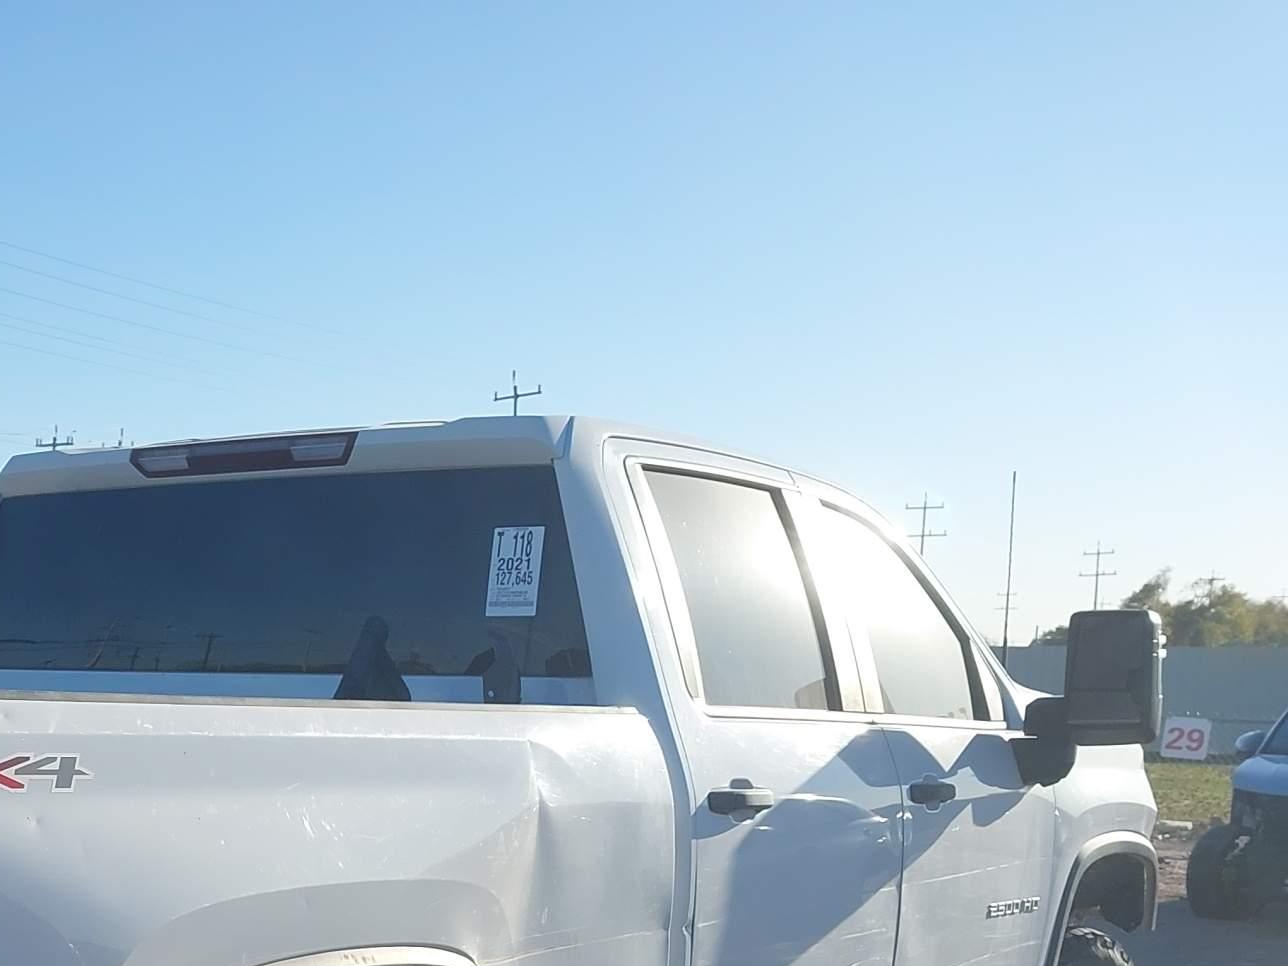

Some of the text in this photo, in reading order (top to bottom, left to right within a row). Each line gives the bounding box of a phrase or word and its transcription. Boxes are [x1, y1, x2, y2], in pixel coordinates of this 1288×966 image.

[496, 530, 533, 557] T 118
[496, 557, 531, 571] 2021
[495, 571, 533, 587] 127,645
[1164, 727, 1205, 752] 29
